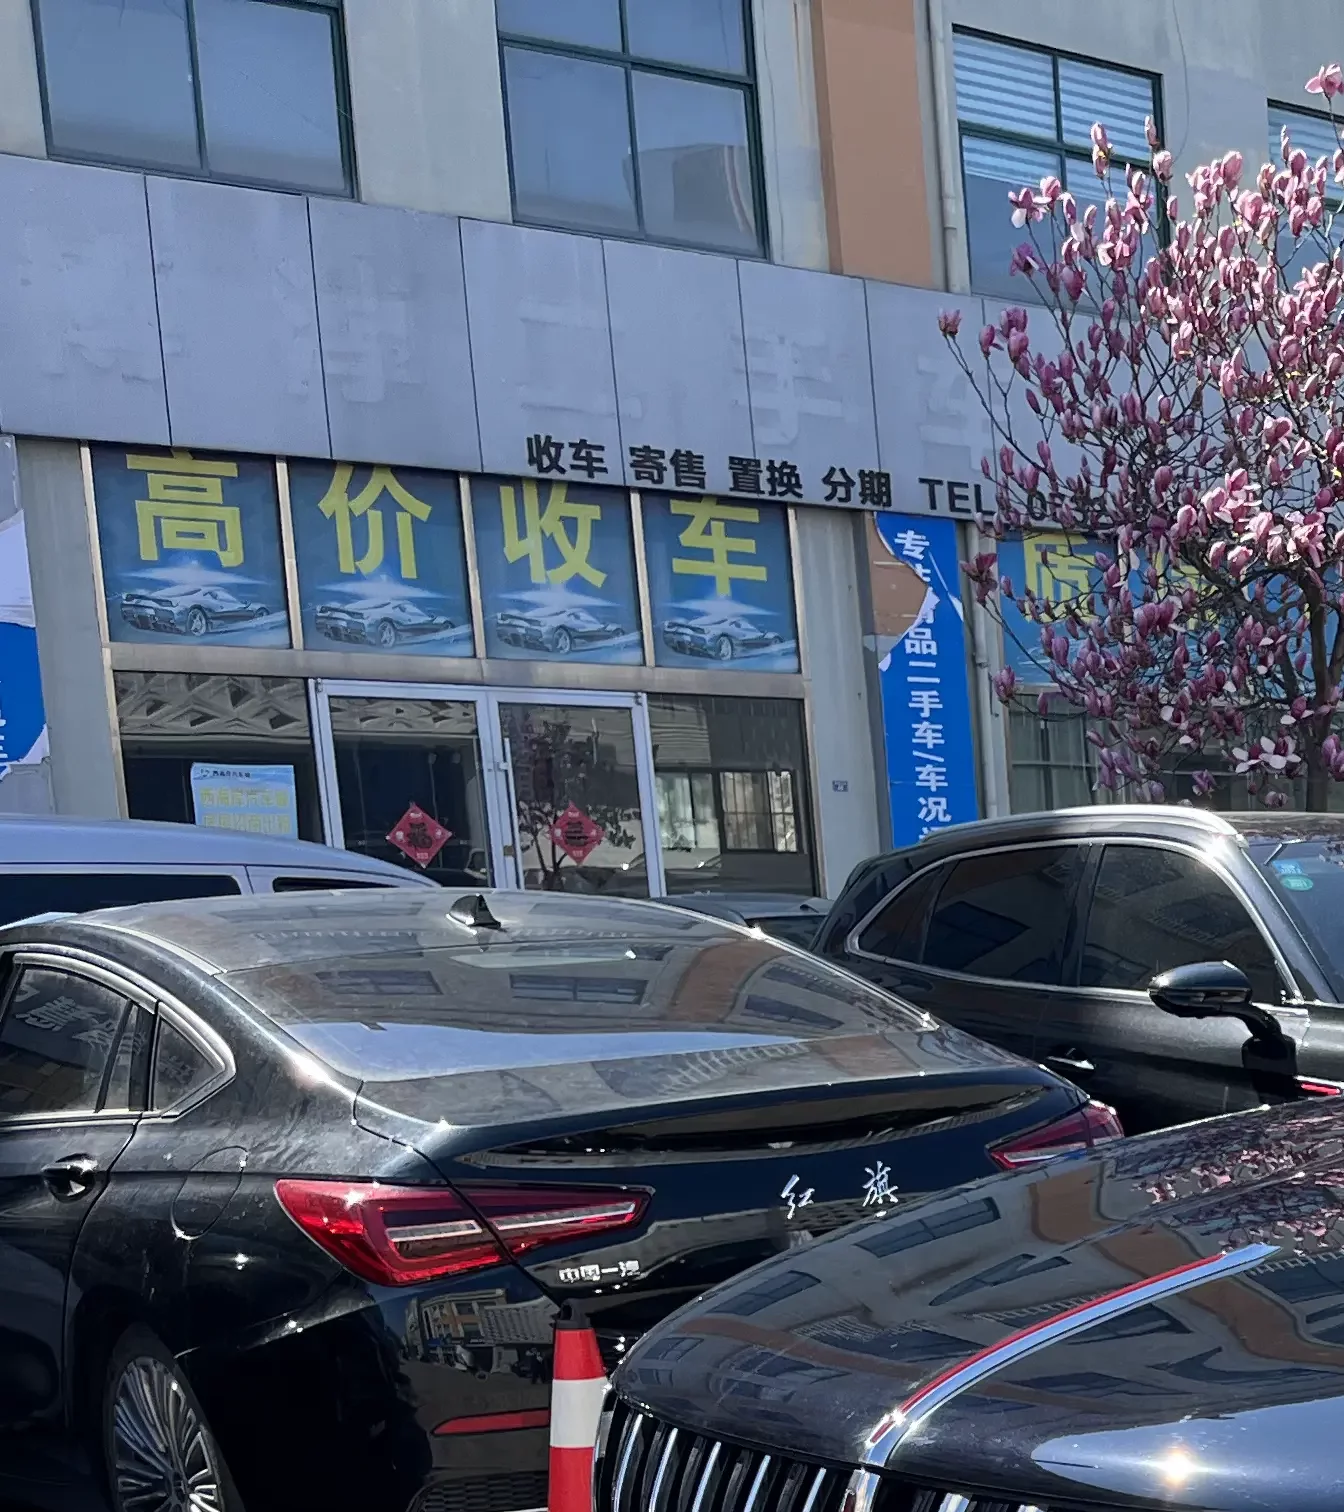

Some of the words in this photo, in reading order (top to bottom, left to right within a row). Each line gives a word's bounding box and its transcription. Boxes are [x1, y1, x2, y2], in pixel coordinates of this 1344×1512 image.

[526, 433, 609, 480] 收车
[628, 444, 707, 490] 寄售
[727, 455, 804, 499] 置换
[821, 466, 893, 508] 分期
[124, 451, 768, 597] 高价收车
[779, 1159, 900, 1220] 红旗
[558, 1259, 642, 1284] 中国一汽
